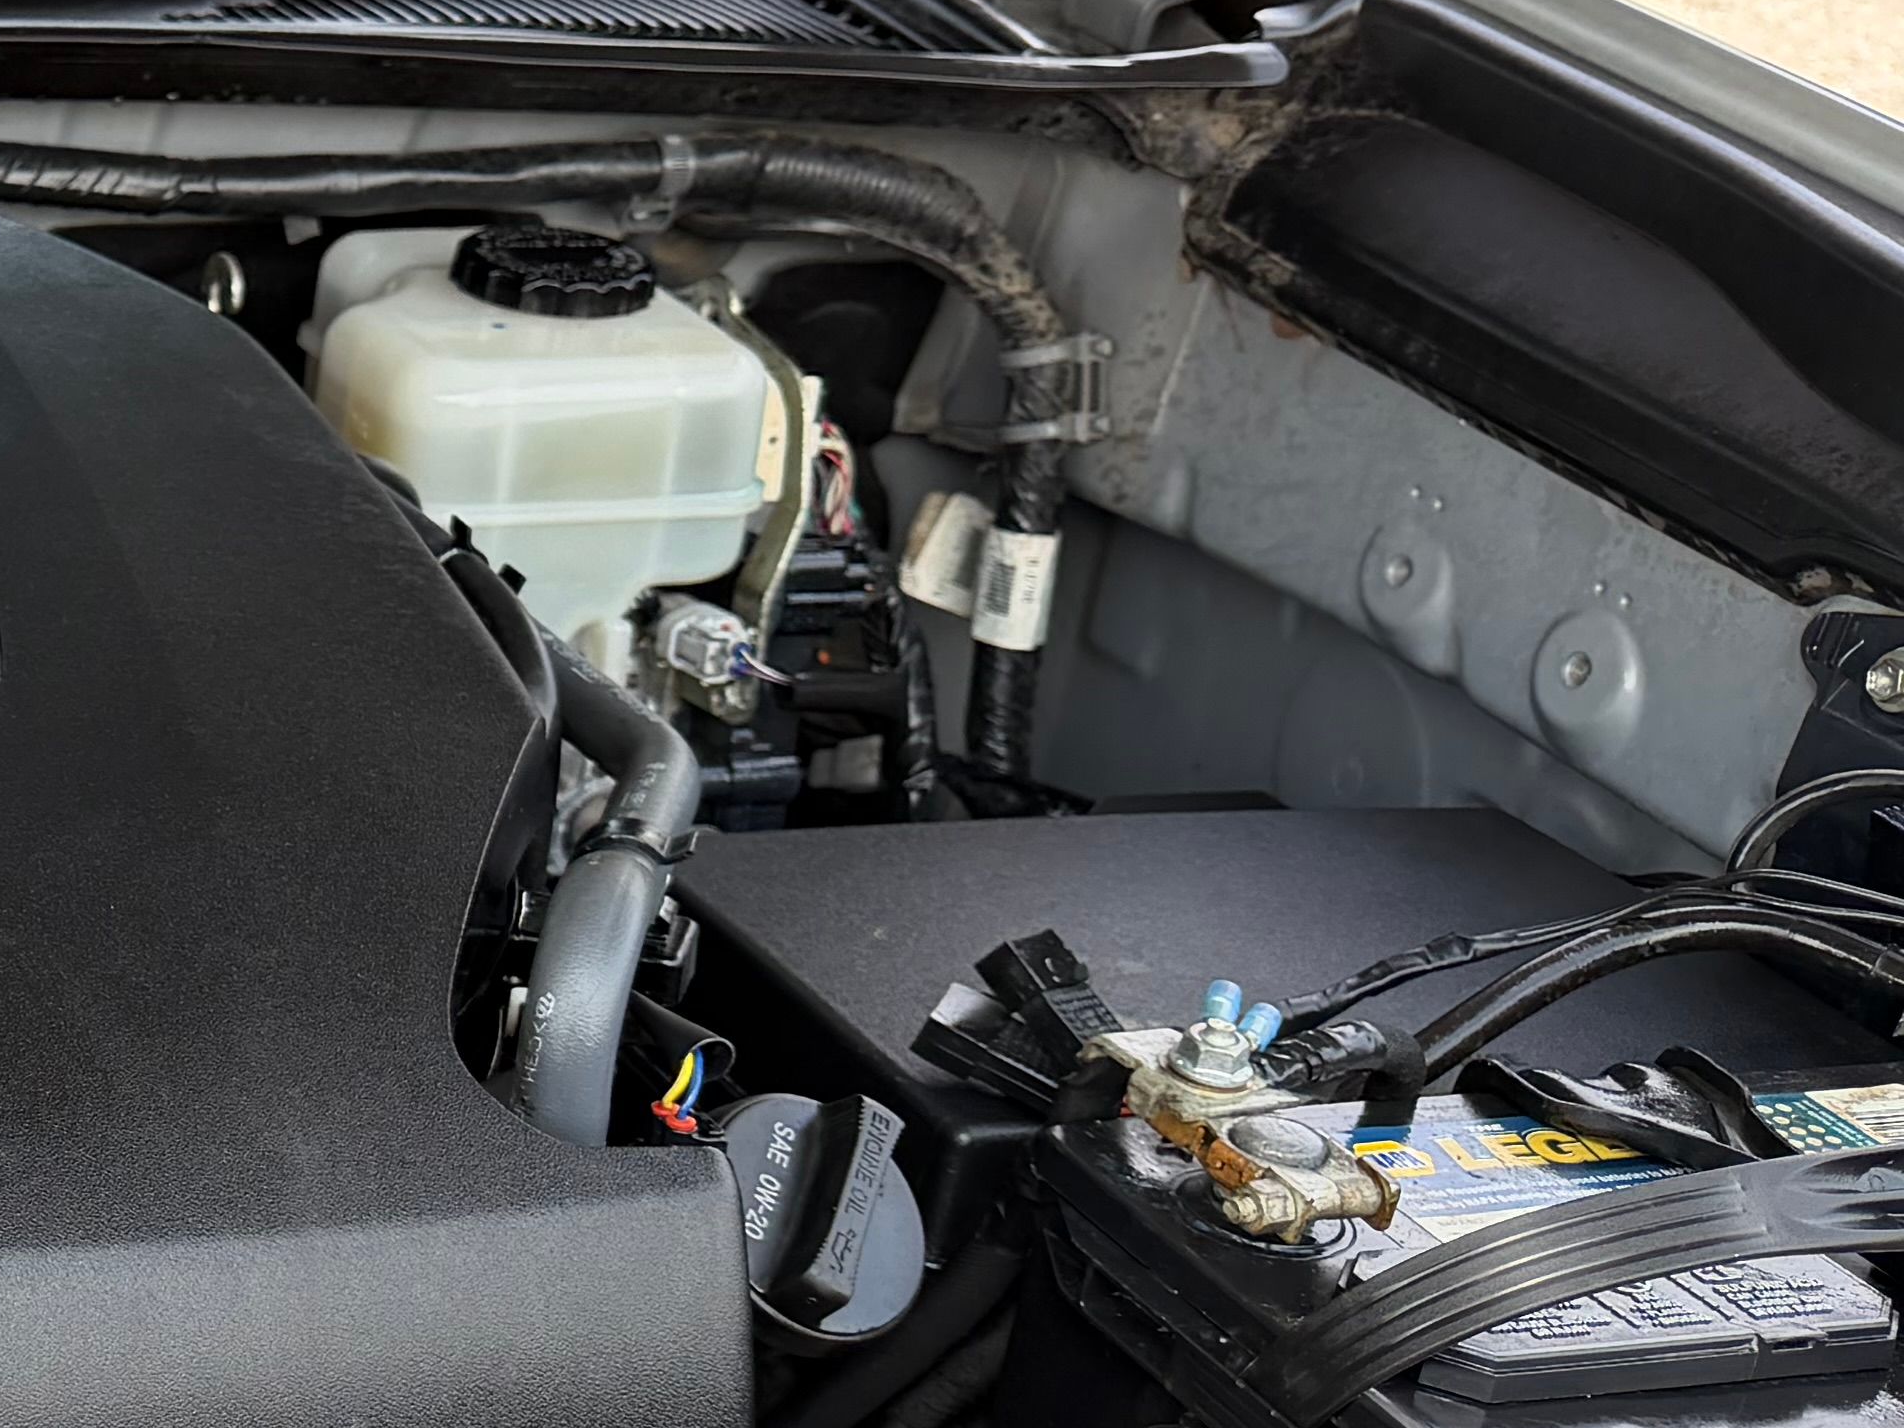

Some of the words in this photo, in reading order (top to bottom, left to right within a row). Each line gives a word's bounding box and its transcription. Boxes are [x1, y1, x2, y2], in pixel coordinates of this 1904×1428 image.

[767, 1122, 795, 1168] SAE
[859, 1112, 890, 1188] ENGINE
[746, 1173, 782, 1241] 0W-20
[844, 1187, 868, 1216] OIL
